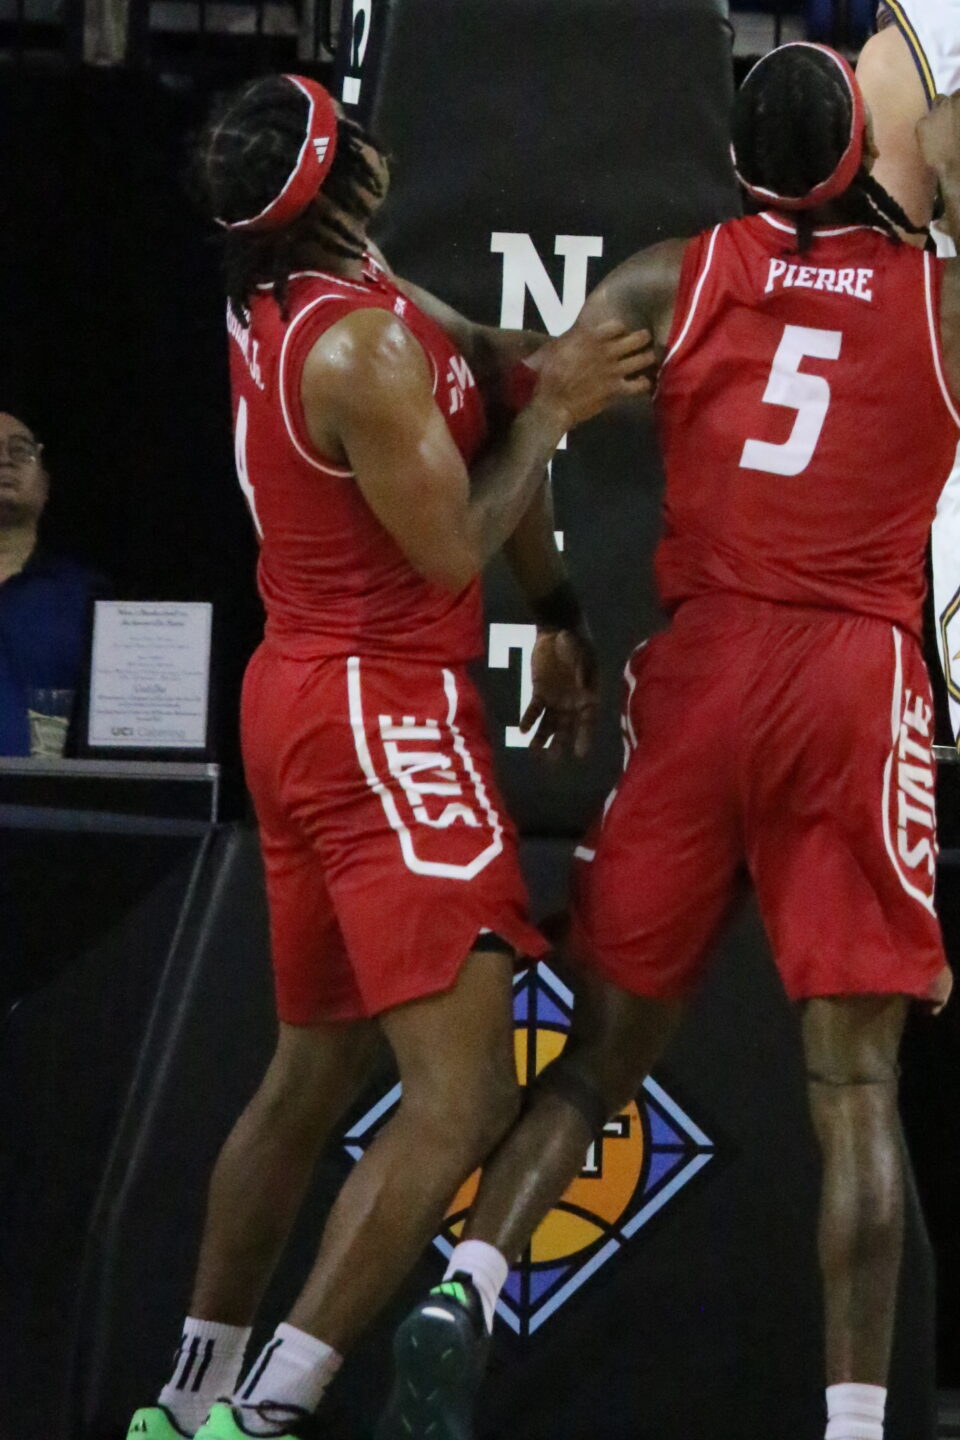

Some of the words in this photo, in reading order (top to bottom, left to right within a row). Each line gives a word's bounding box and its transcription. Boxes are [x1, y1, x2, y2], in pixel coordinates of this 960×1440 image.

[764, 257, 874, 303] PIERRE
[738, 324, 843, 477] 5
[898, 689, 937, 877] STATE
